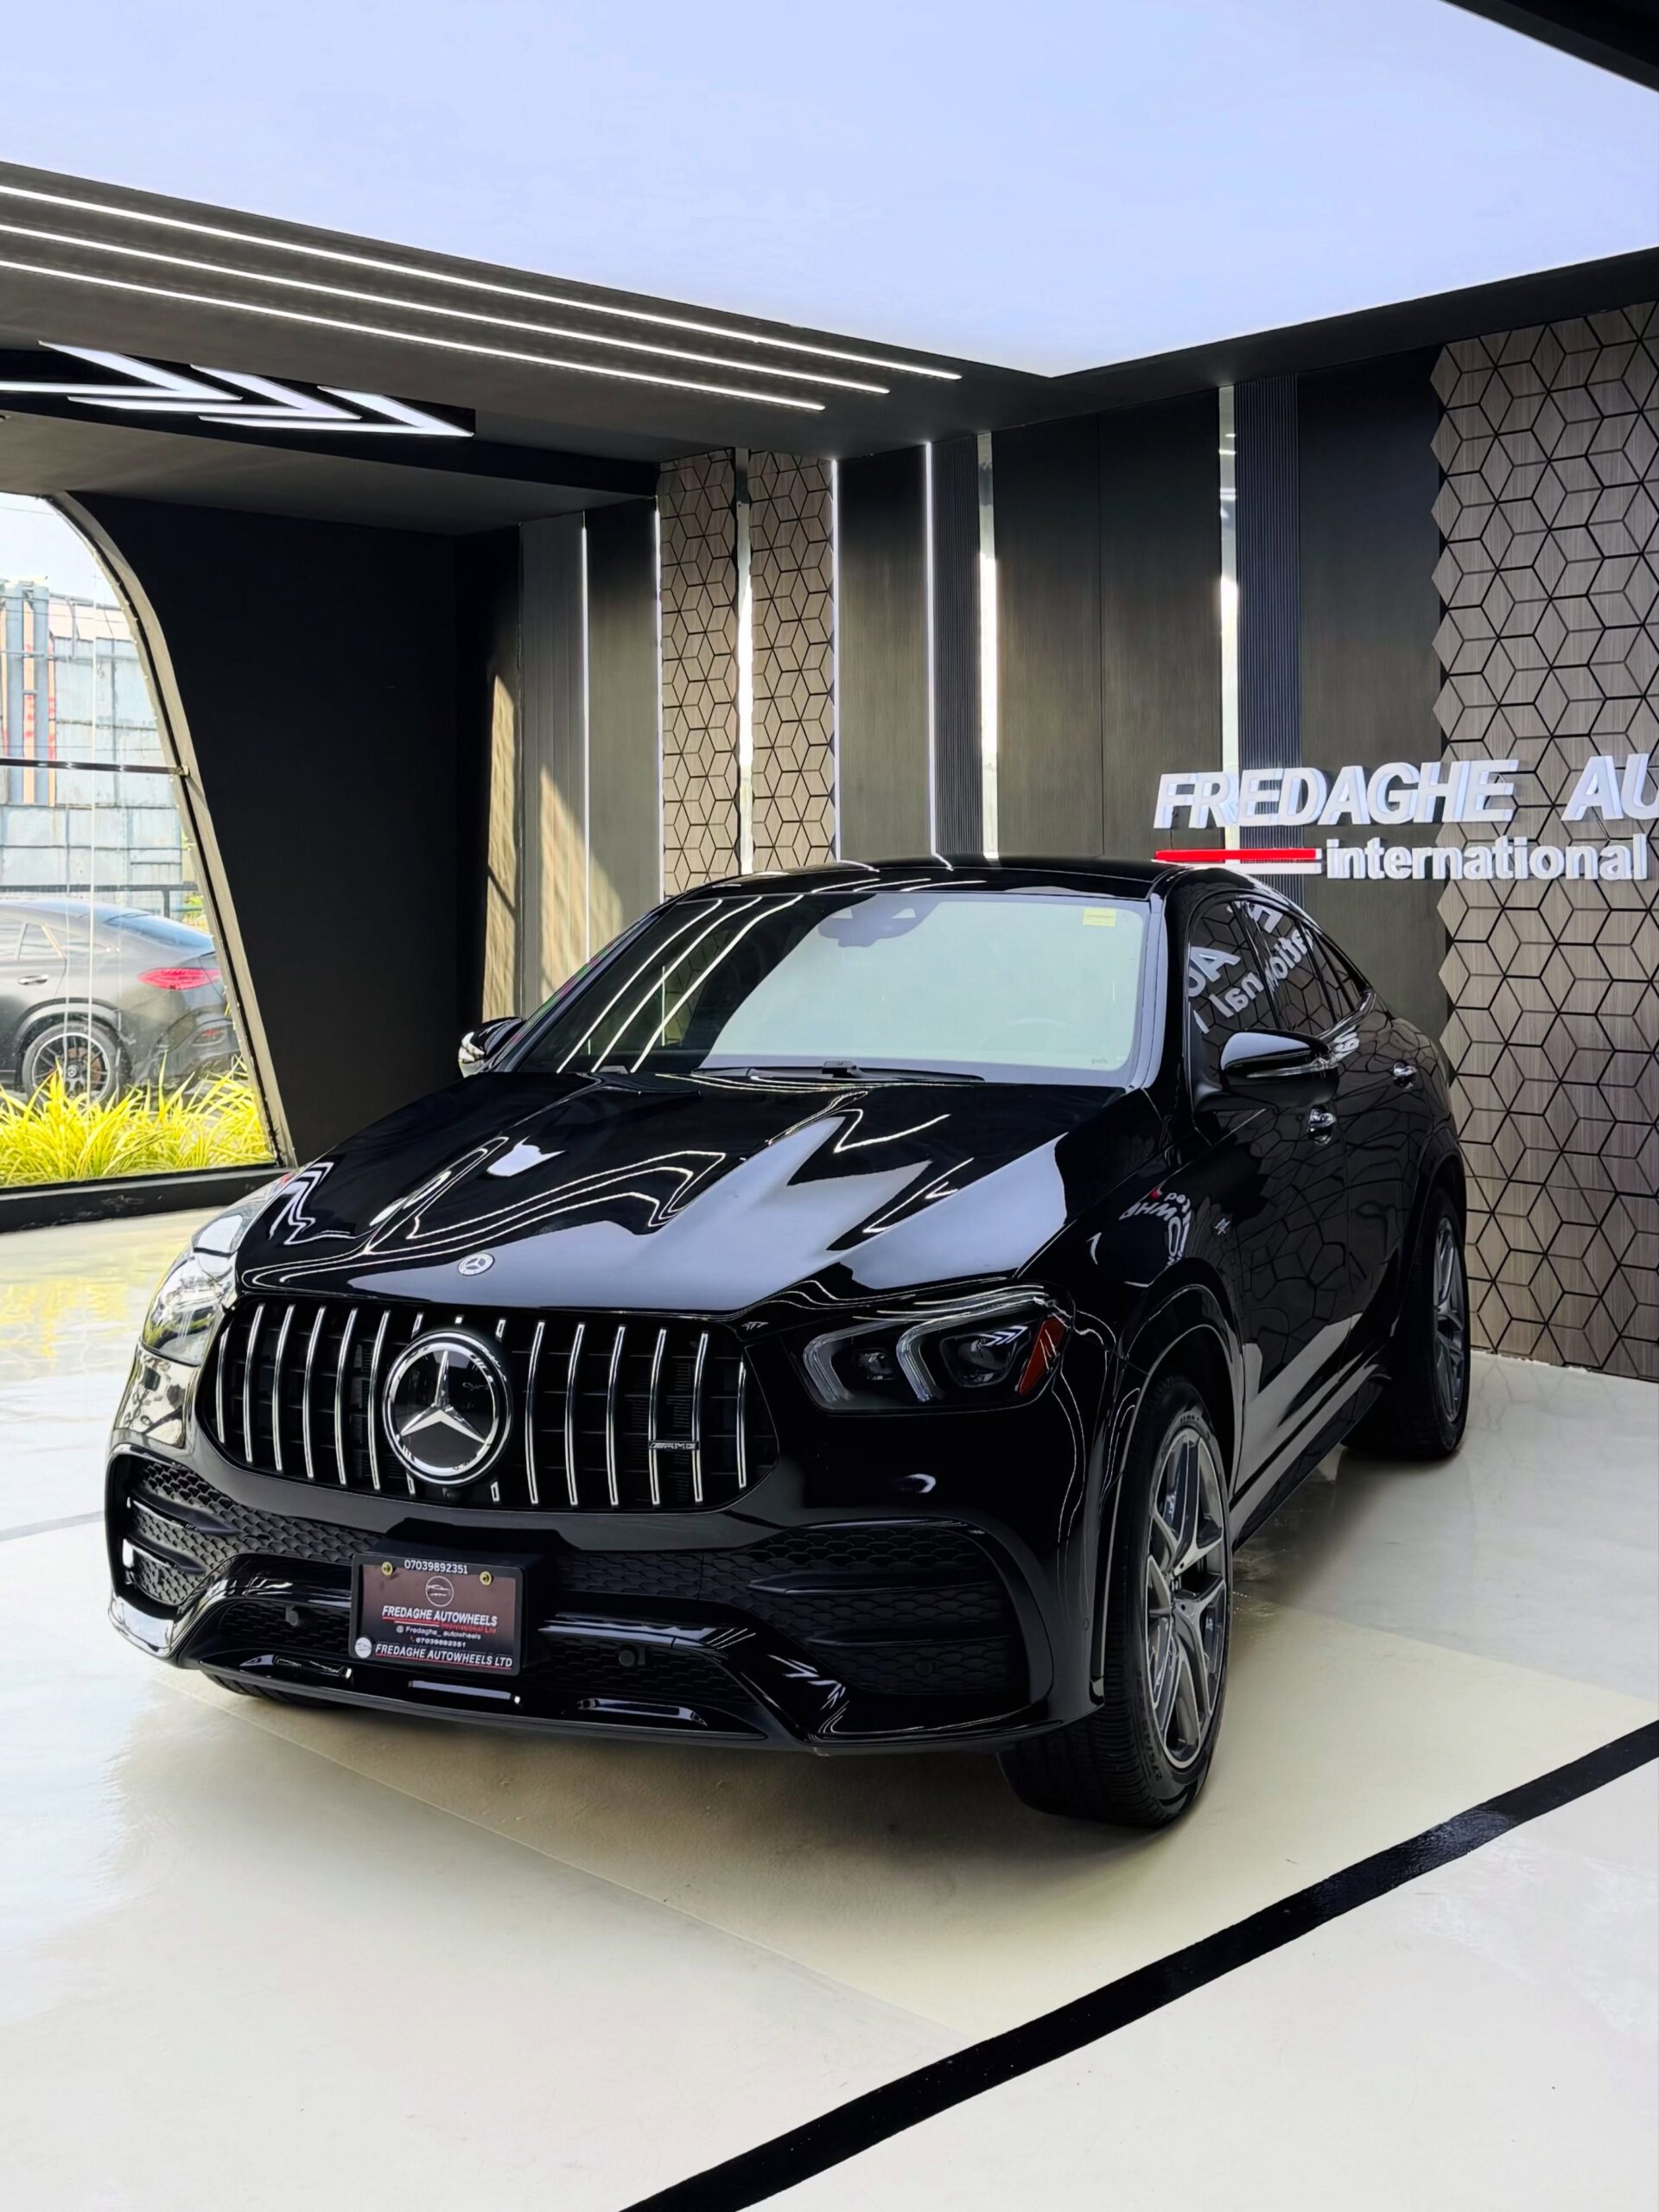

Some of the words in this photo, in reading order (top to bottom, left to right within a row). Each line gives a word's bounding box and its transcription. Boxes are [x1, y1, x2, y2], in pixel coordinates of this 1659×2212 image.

[1154, 760, 1519, 829] FREDAGHE
[1326, 833, 1648, 880] international
[404, 1559, 468, 1574] 07039892351
[382, 1605, 433, 1620] FREDAGHE
[433, 1610, 498, 1627] AUTOWHEELS
[375, 1643, 425, 1658] FREDAGHE
[427, 1649, 493, 1666] AUTOWHEELS
[494, 1656, 513, 1668] LTD
